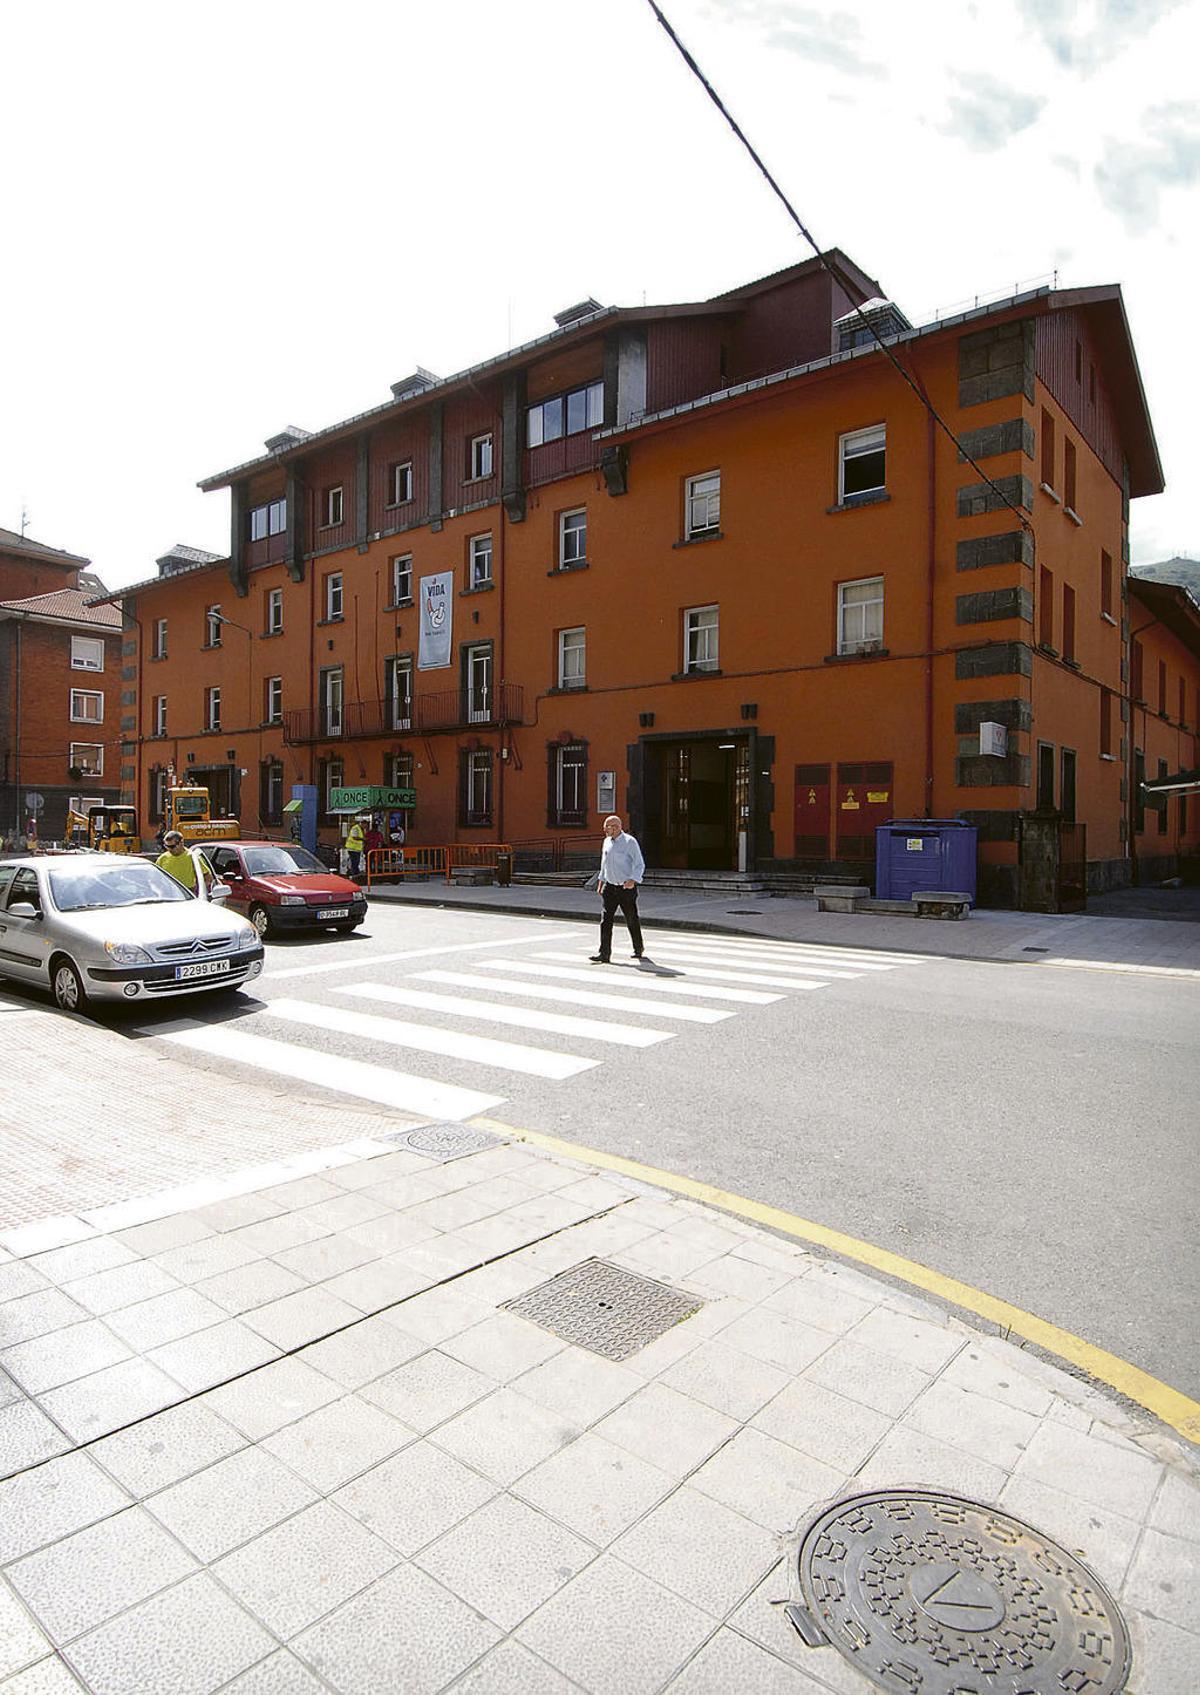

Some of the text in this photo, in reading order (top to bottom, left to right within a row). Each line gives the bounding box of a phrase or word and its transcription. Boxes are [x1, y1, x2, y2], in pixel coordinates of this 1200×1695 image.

[427, 581, 445, 597] VIDA
[343, 792, 368, 803] ONCE
[388, 793, 416, 804] ONCE
[183, 964, 208, 977] 2299
